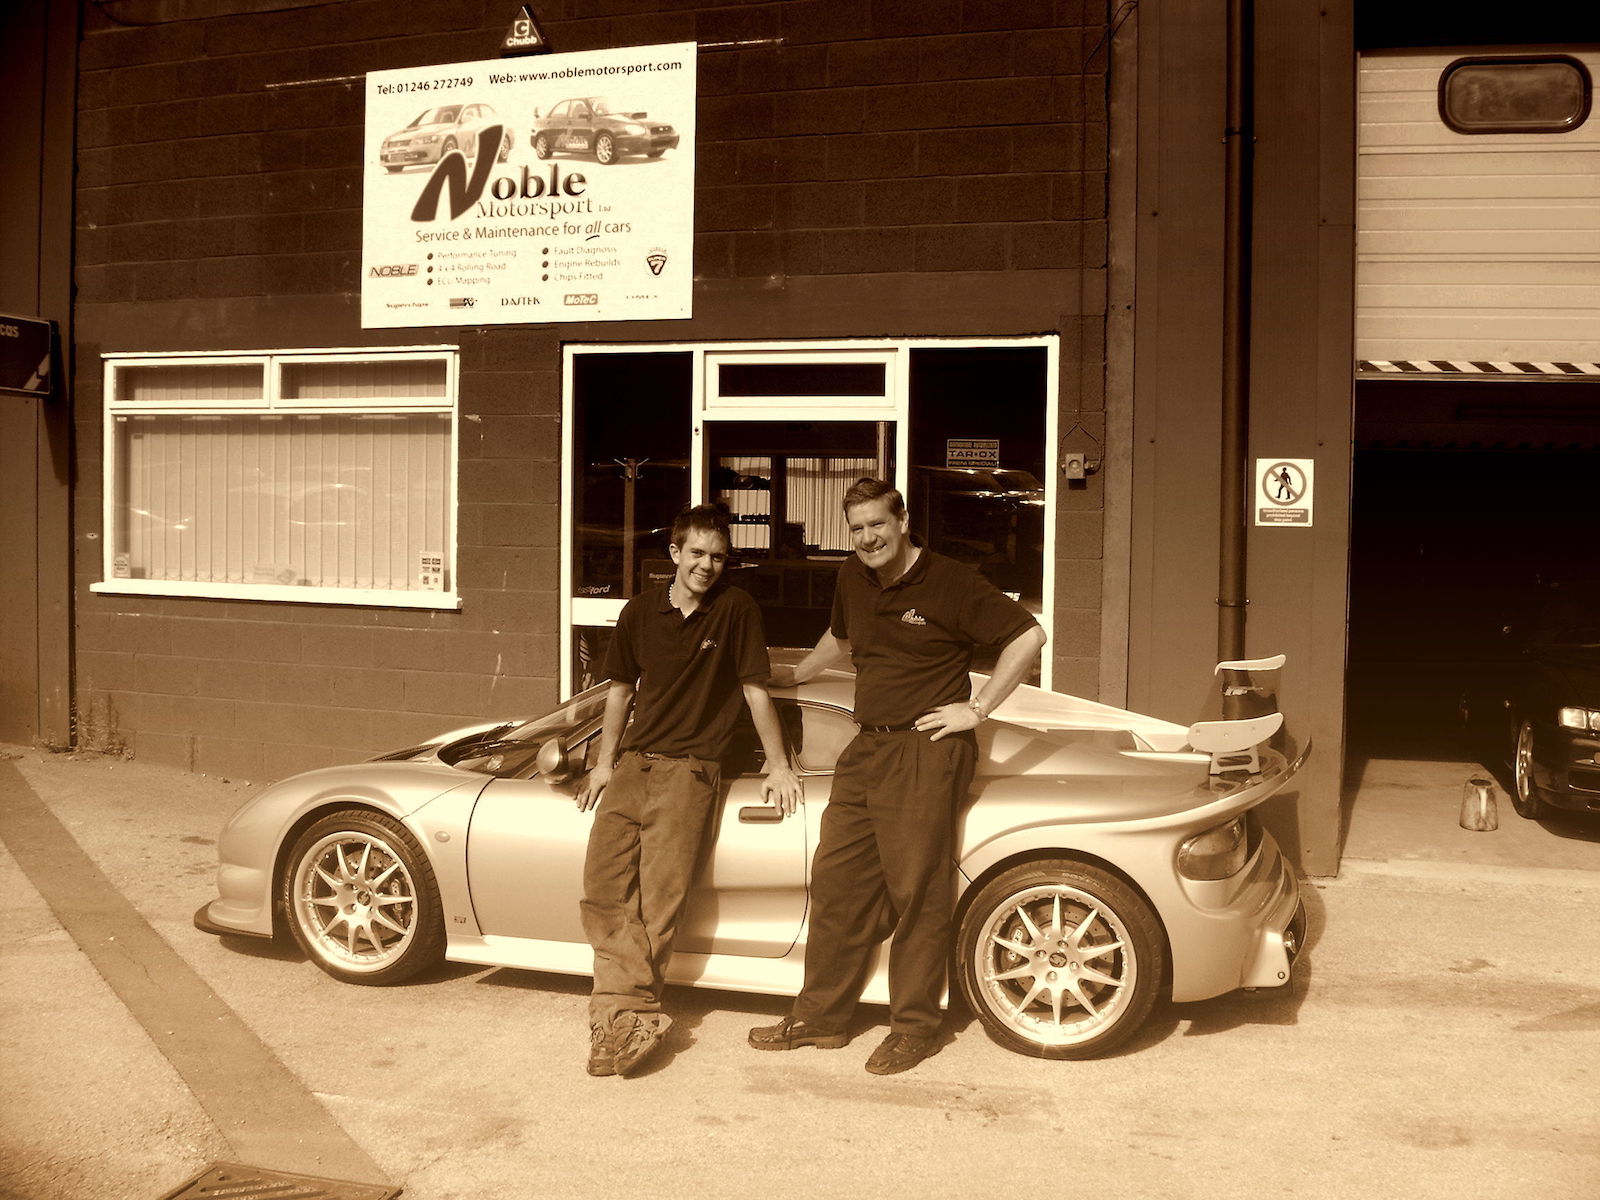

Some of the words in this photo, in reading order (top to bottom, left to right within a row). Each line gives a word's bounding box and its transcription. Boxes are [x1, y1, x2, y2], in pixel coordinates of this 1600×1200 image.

[506, 36, 538, 47] Chubb
[488, 73, 517, 85] Web:
[519, 61, 682, 83] www.noblemotorsport.com
[377, 84, 395, 95] Tel:
[396, 81, 430, 94] 01246
[433, 76, 474, 90] 272749
[410, 124, 588, 223] Noble
[476, 198, 593, 220] Motorsport
[415, 228, 460, 243] Service
[462, 228, 472, 240] &
[475, 222, 560, 240] Maintenance
[563, 222, 581, 235] for
[584, 221, 602, 235] all
[604, 221, 632, 234] cars
[437, 251, 487, 260] Performance
[489, 248, 517, 258] Tuning
[554, 246, 575, 255] Fault
[577, 246, 618, 256] Diagnosis
[457, 263, 485, 273] Rolling
[486, 262, 507, 271] Road
[554, 259, 583, 270] Engine
[585, 258, 621, 268] Rebuilds
[370, 264, 418, 277] NOBLE
[554, 272, 578, 282] Chips
[579, 271, 604, 281] Fitted
[455, 275, 491, 285] Mapping
